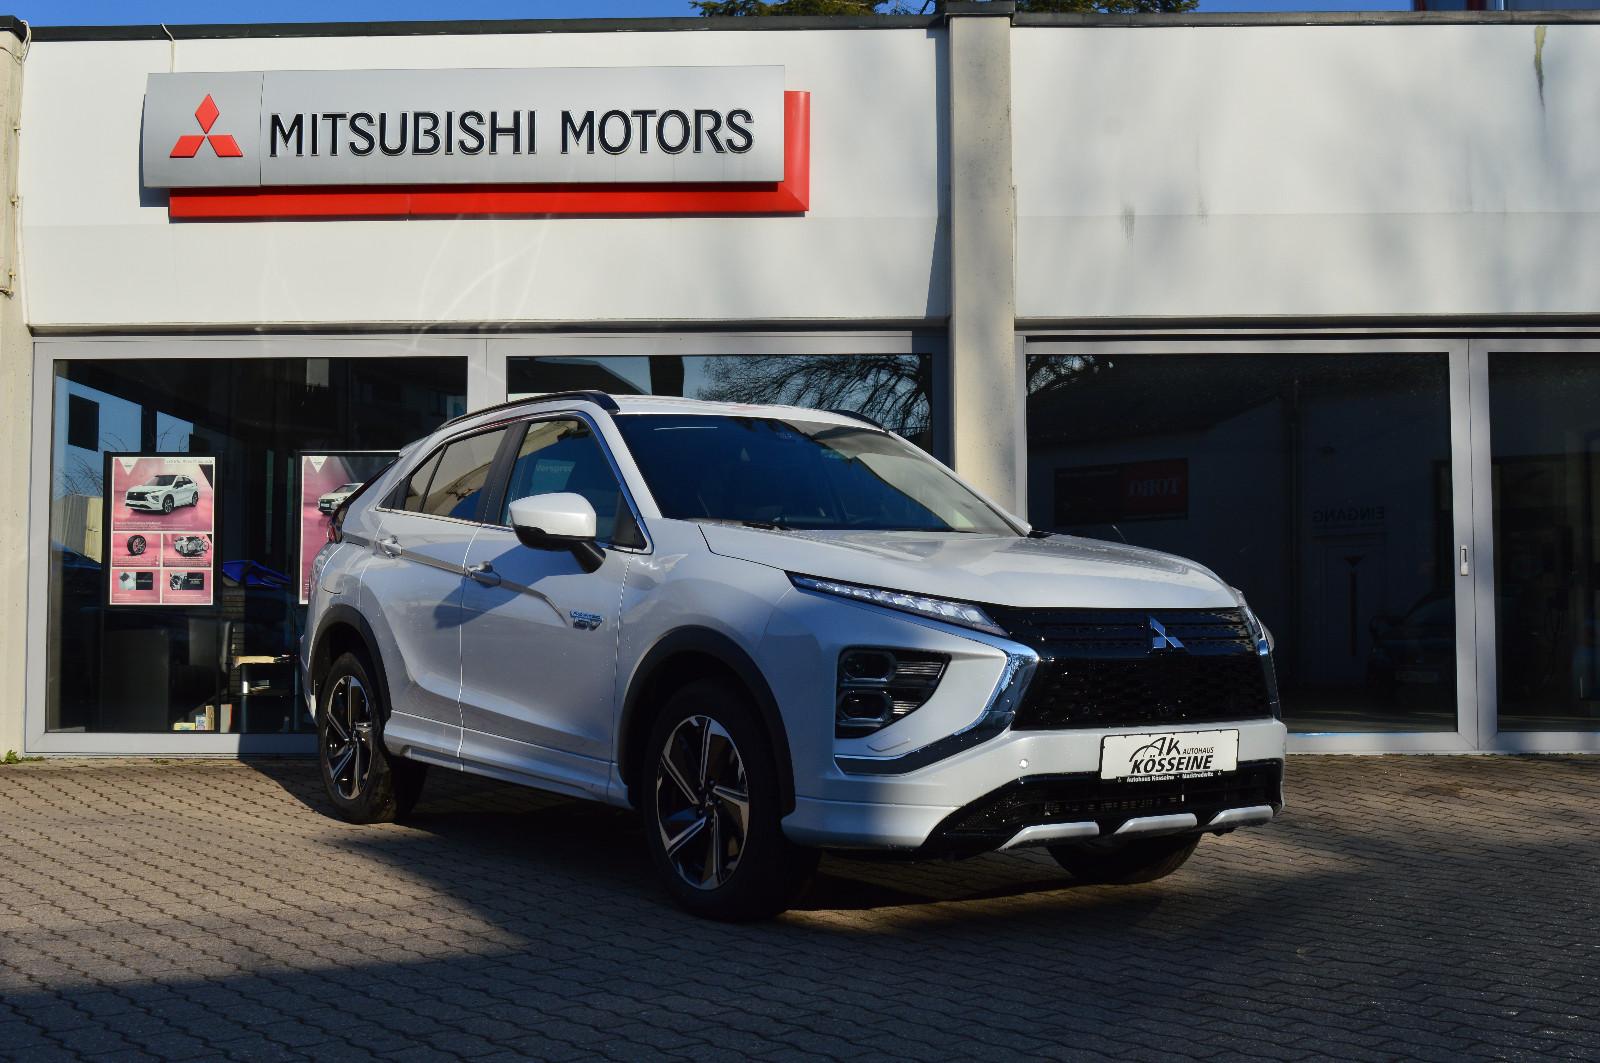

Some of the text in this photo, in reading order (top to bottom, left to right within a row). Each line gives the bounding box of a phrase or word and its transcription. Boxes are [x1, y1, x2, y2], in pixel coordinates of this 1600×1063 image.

[269, 109, 754, 157] MITSUBISHI MOTORS
[1129, 737, 1181, 762] AK
[1183, 747, 1214, 755] AUTOHAUS
[1131, 755, 1214, 774] KÖSSEINE
[1127, 775, 1151, 783] Autohaus
